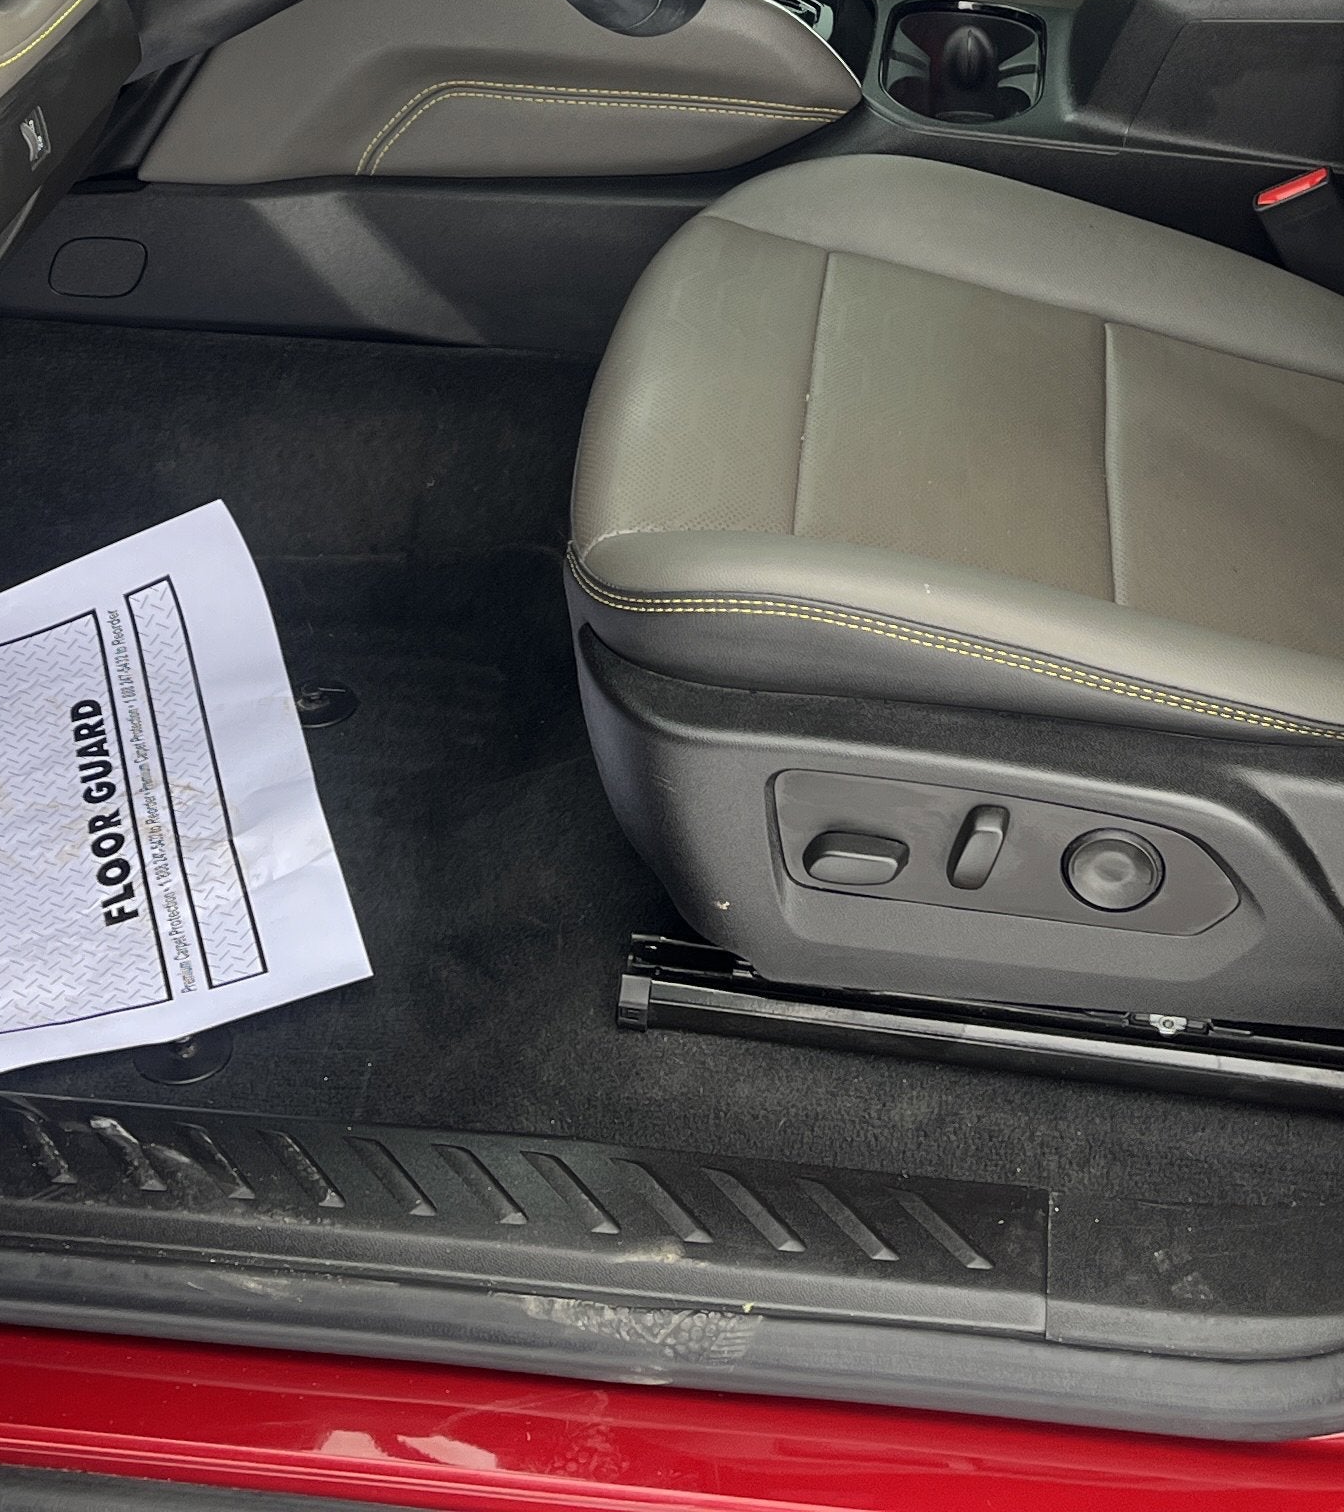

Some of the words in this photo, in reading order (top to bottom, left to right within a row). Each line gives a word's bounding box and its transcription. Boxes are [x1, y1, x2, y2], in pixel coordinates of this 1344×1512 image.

[106, 610, 125, 646] Reorder
[128, 708, 144, 742] Protection
[70, 699, 117, 805] GUARD
[133, 742, 149, 764] Carpet
[137, 764, 154, 793] Premium
[144, 795, 160, 824] Reorder
[88, 808, 139, 926] FLOOR
[163, 891, 185, 937] Protection
[173, 938, 191, 962] Carpet
[179, 962, 197, 994] Premium
